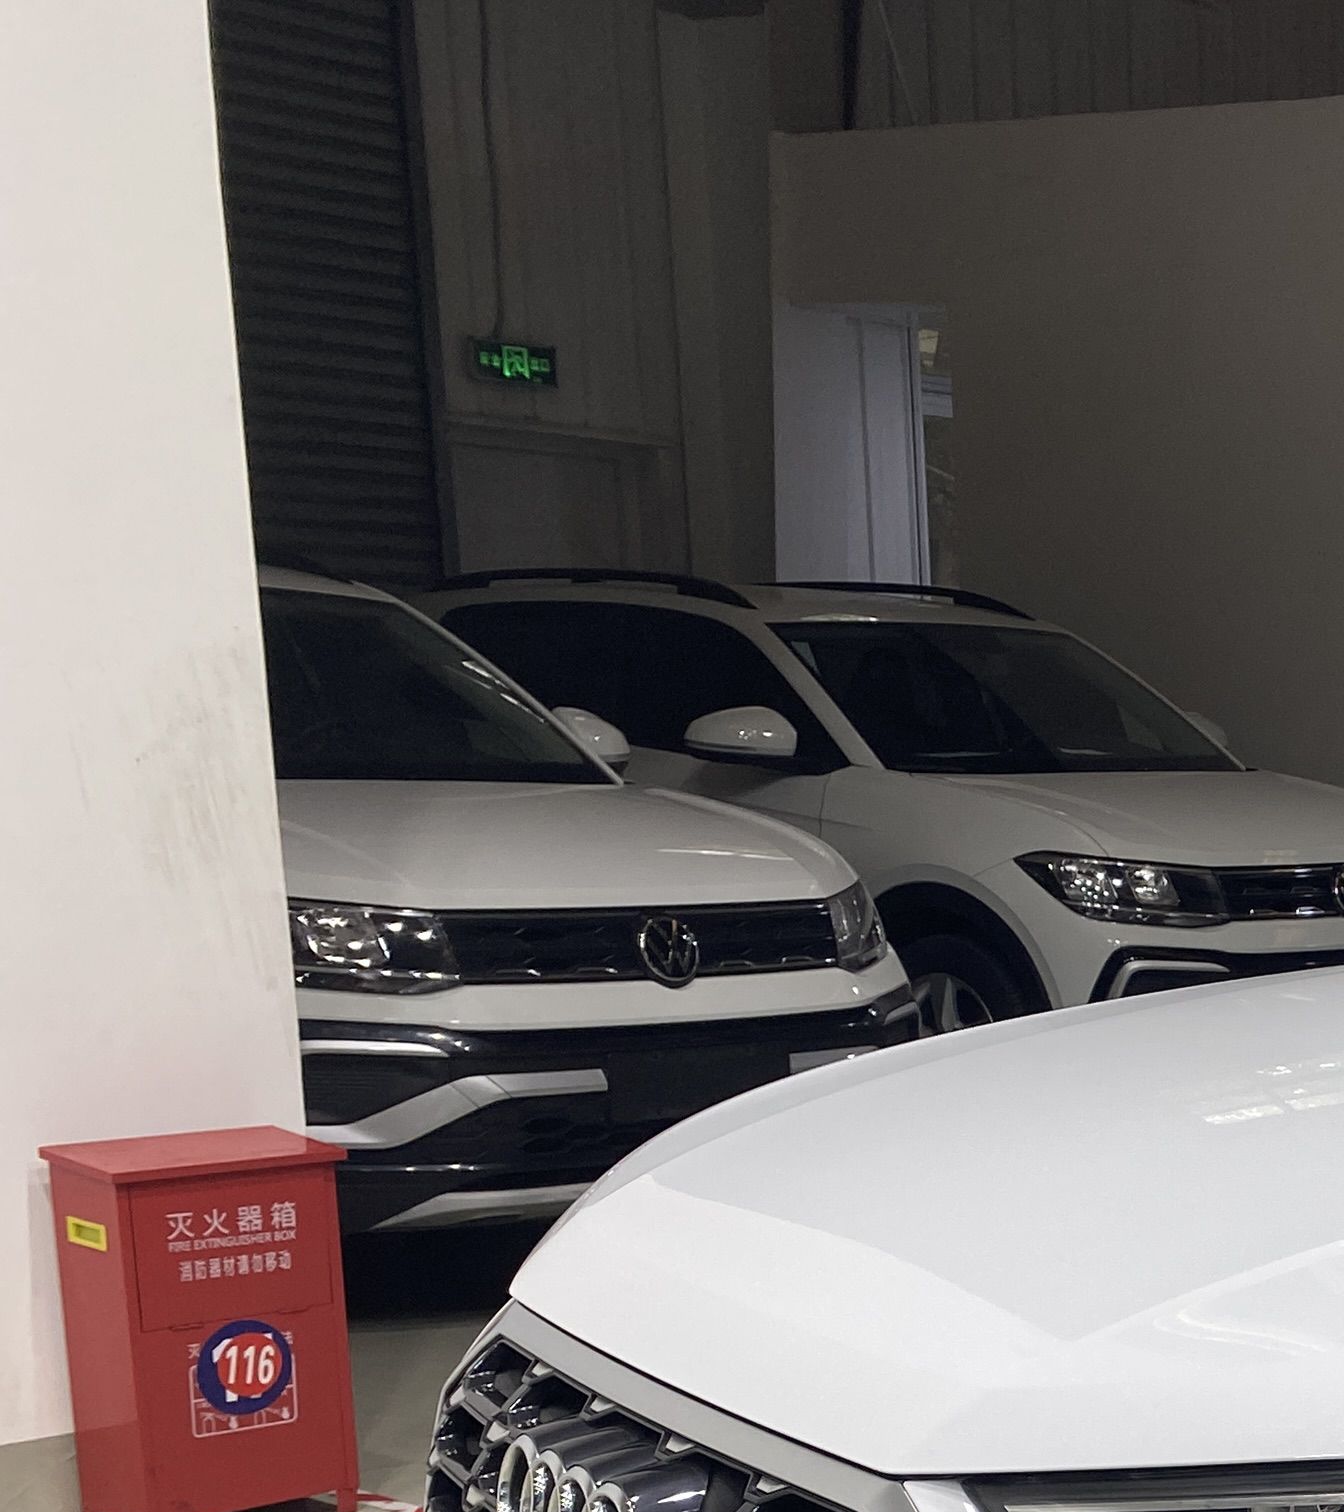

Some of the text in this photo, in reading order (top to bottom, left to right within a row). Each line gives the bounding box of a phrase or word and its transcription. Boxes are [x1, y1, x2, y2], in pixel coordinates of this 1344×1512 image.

[165, 1201, 297, 1240] 灭火器箱
[168, 1229, 297, 1253] FIRE EXTINGUISHER BOX
[225, 1344, 276, 1385] 116
